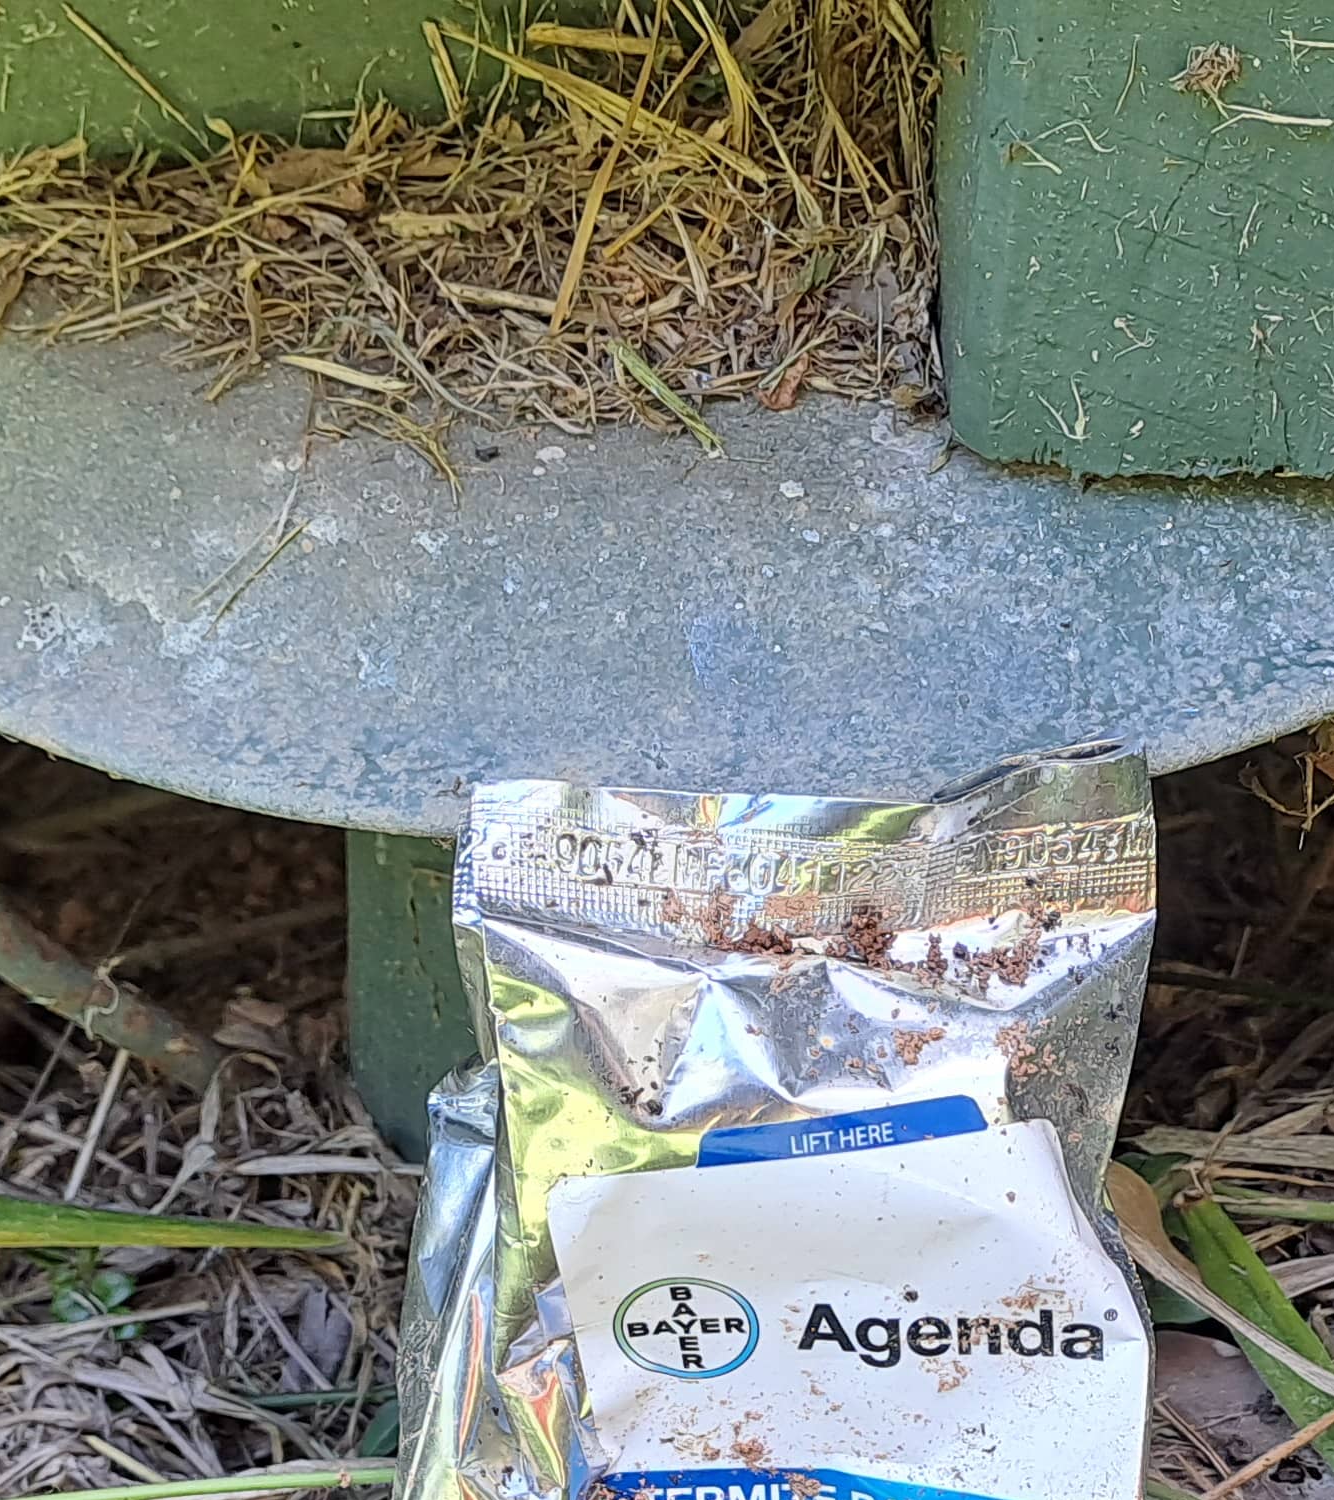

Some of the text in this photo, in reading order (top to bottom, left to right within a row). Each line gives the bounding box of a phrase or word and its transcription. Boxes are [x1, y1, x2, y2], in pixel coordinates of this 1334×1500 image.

[789, 1121, 895, 1155] LIFT HERE
[626, 1317, 747, 1338] BAYER
[669, 1285, 707, 1369] BAYER
